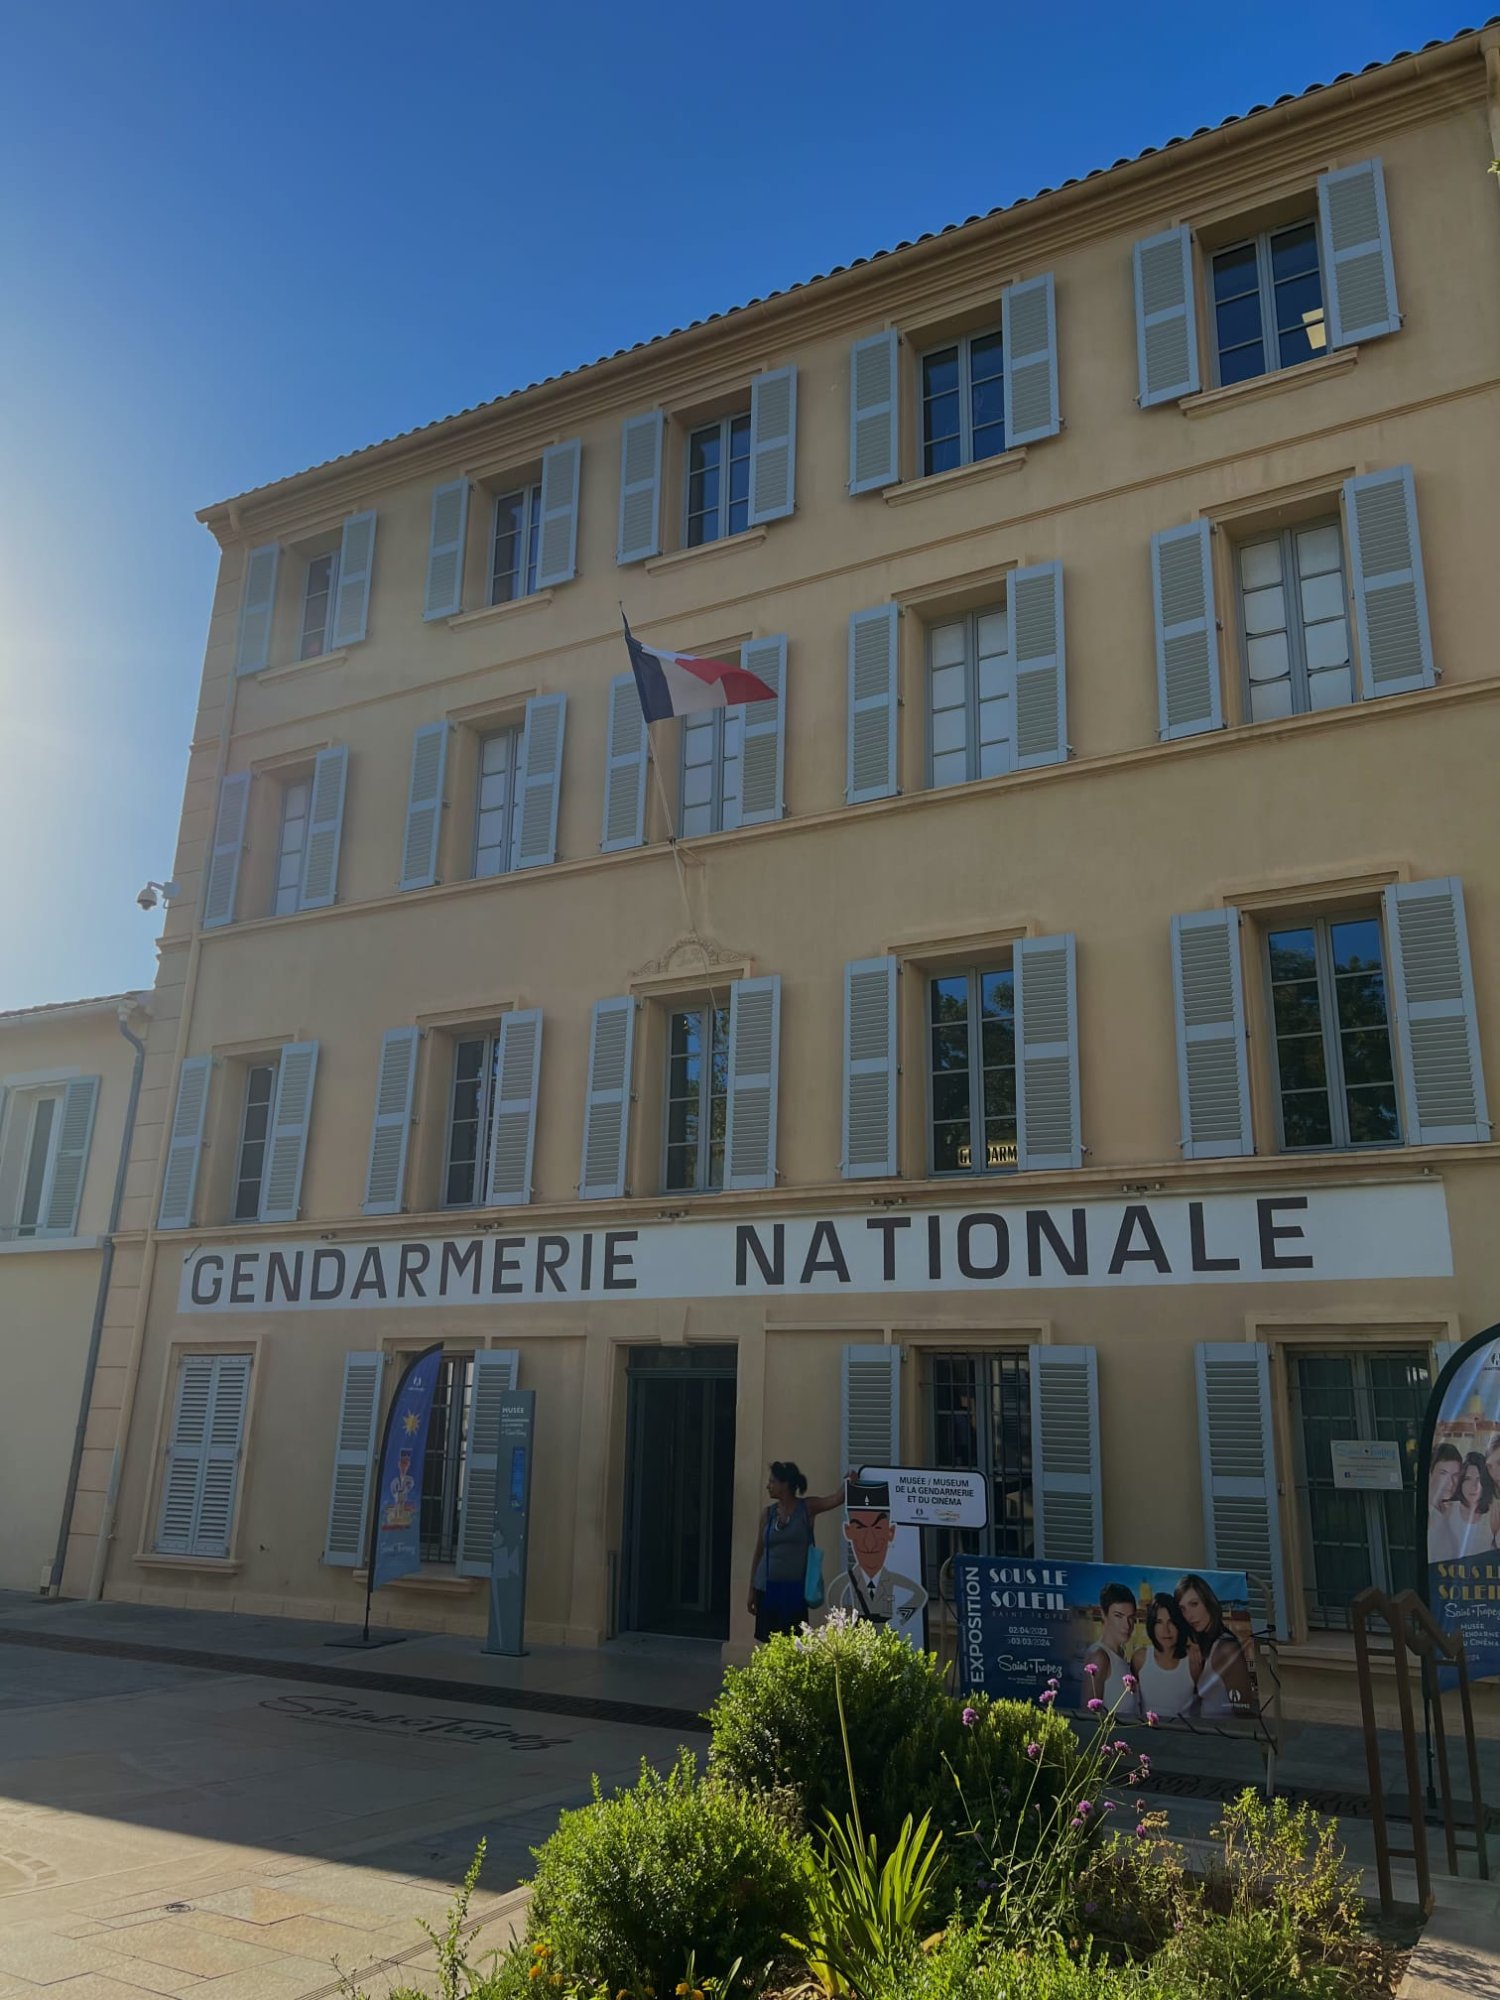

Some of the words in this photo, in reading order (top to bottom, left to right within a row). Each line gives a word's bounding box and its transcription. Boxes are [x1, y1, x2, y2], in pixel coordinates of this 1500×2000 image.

[191, 1230, 638, 1306] GENDARMERIE
[736, 1197, 1313, 1286] NATIONALE
[895, 1485, 905, 1493] DE
[907, 1486, 917, 1494] LA
[918, 1486, 975, 1497] GENDARMERIE
[933, 1478, 969, 1487] MUSEUM
[918, 1496, 930, 1504] DU
[989, 1567, 1037, 1585] SOUS
[1042, 1569, 1069, 1587] LE
[1438, 1563, 1480, 1579] SOUS
[990, 1590, 1071, 1611] SOLEIL
[1444, 1602, 1471, 1618] Saint
[965, 1566, 985, 1683] EXPOSITION
[997, 1654, 1029, 1672] Saint
[1028, 1658, 1063, 1679] Tropez
